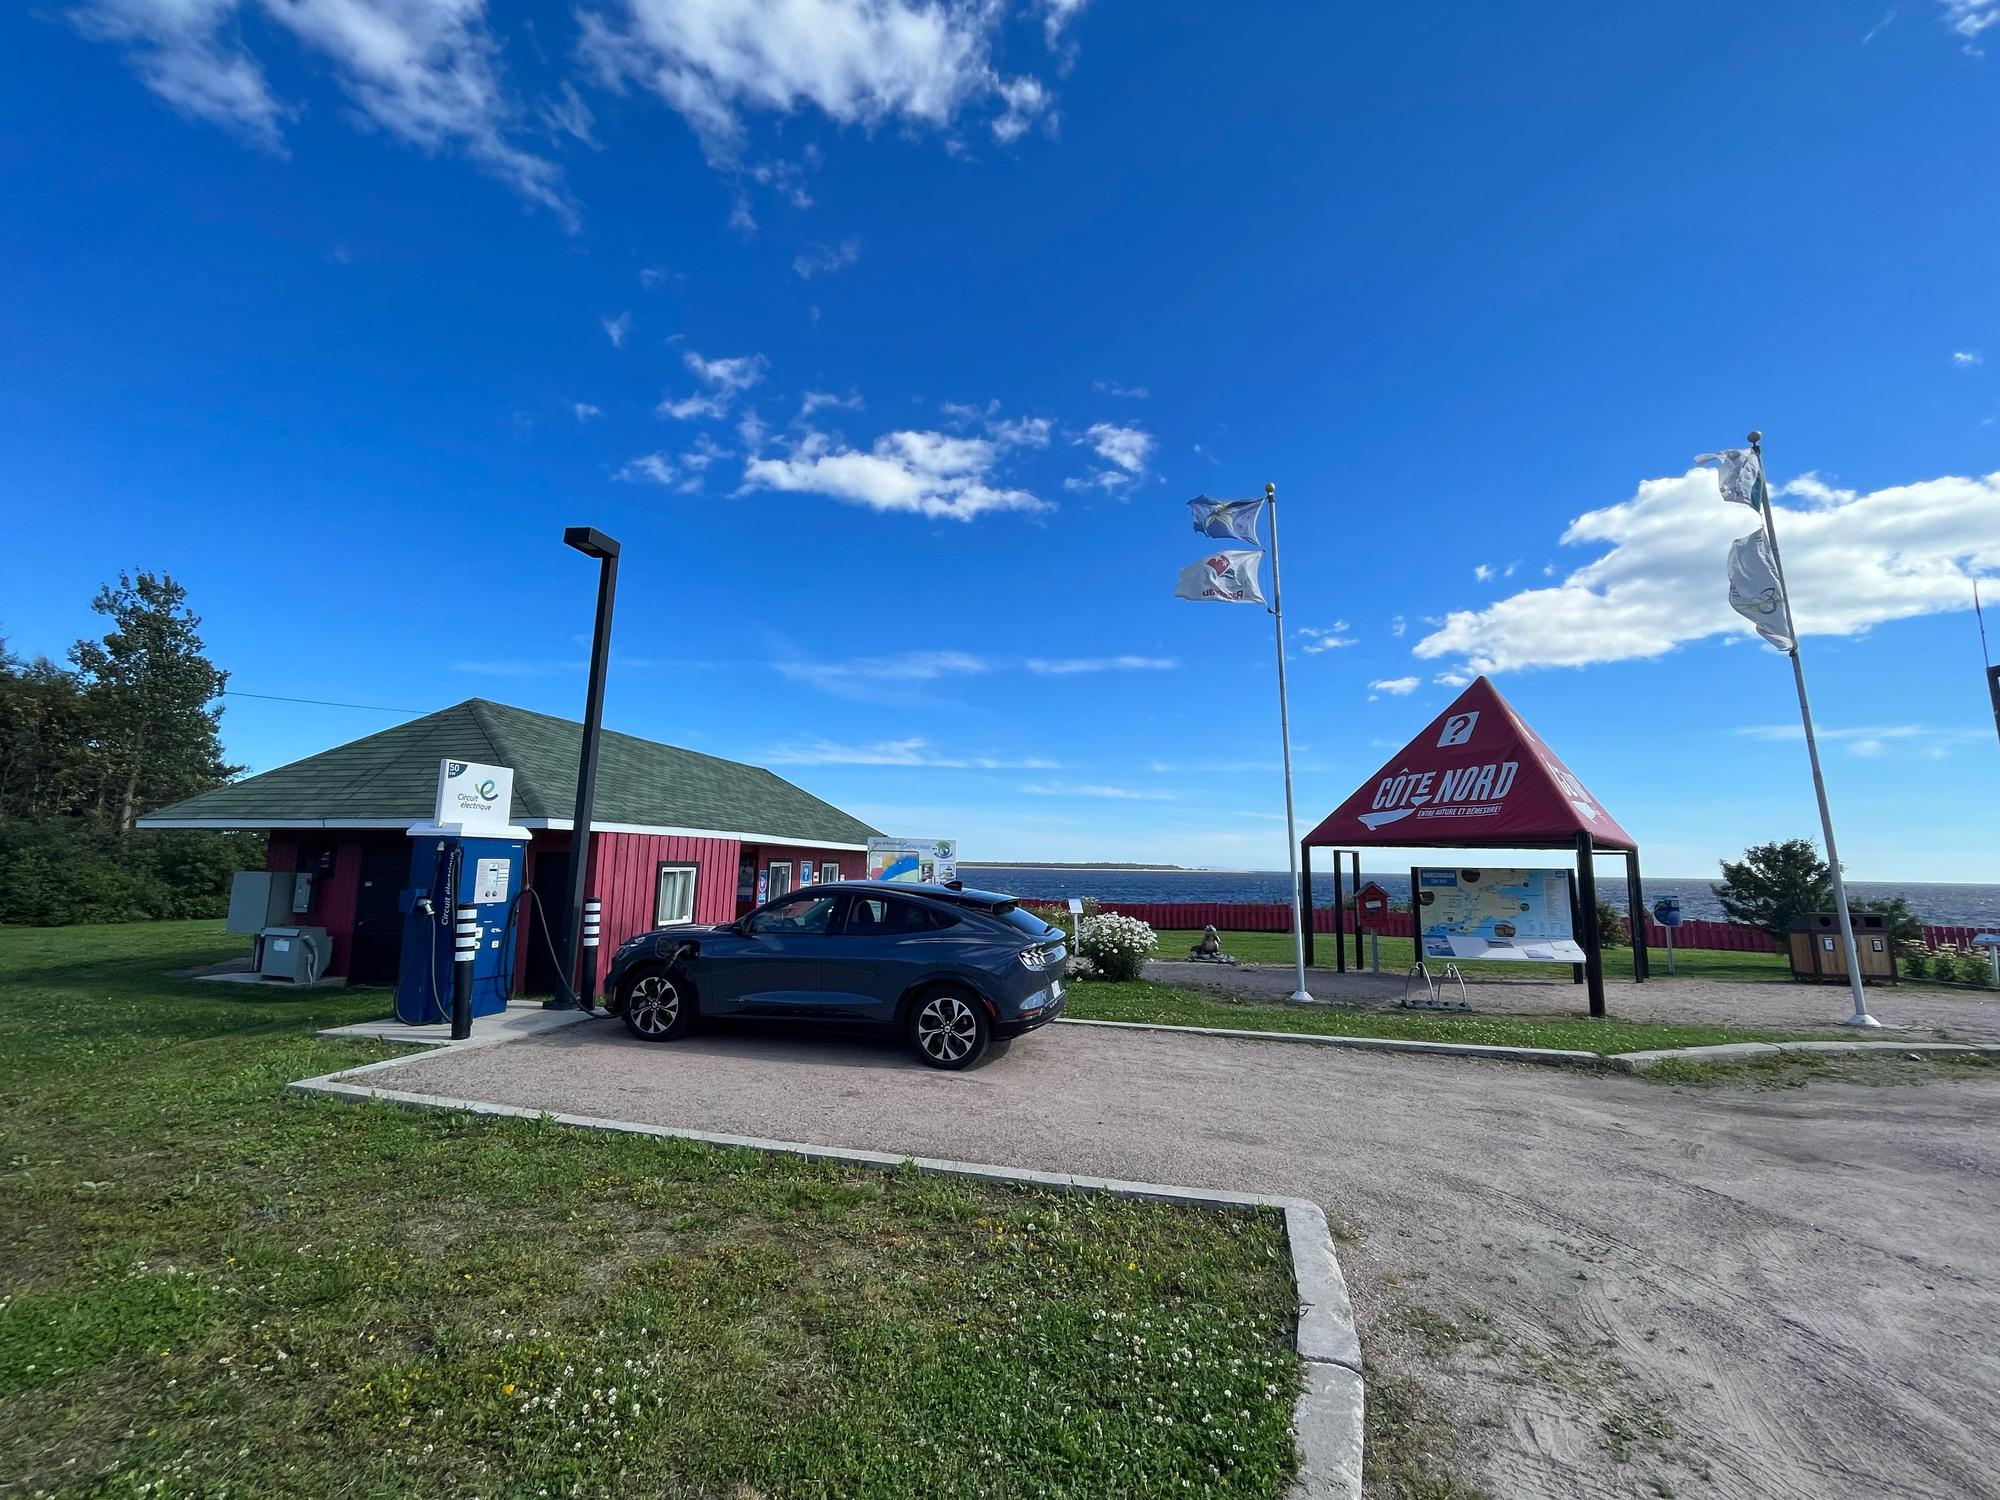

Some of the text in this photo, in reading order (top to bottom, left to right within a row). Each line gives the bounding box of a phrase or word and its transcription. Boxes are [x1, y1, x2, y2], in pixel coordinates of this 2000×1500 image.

[449, 763, 460, 772] 50
[1371, 768, 1437, 810] CÔTE
[1432, 761, 1519, 804] NORD
[457, 793, 478, 802] Circuit
[1457, 806, 1466, 815] ET
[441, 897, 451, 926] Circuit
